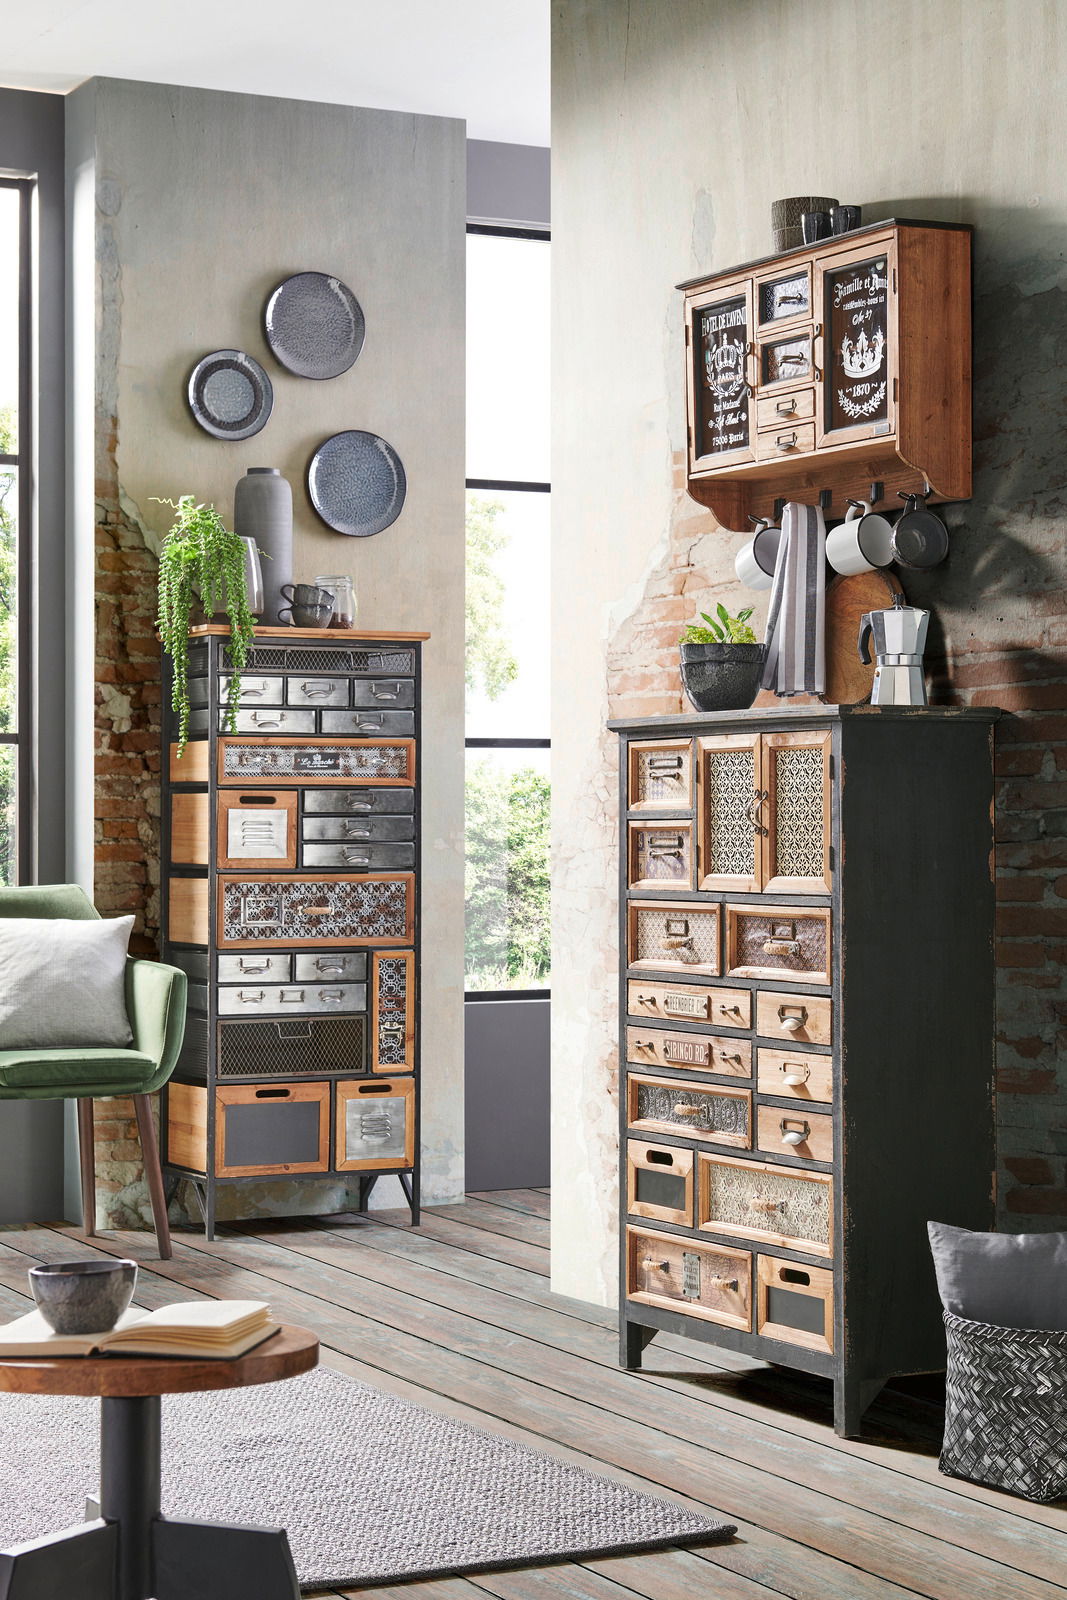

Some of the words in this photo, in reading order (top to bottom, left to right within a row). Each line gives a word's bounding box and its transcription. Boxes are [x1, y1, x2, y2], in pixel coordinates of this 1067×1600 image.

[834, 277, 863, 308] Famille
[864, 276, 871, 289] et
[868, 274, 888, 296] Ami
[701, 315, 719, 337] HOTEL
[718, 313, 726, 330] DE
[717, 372, 735, 384] PARIS
[853, 383, 871, 397] 1870
[729, 431, 744, 445] Paris
[665, 1040, 693, 1061] SIRINGO
